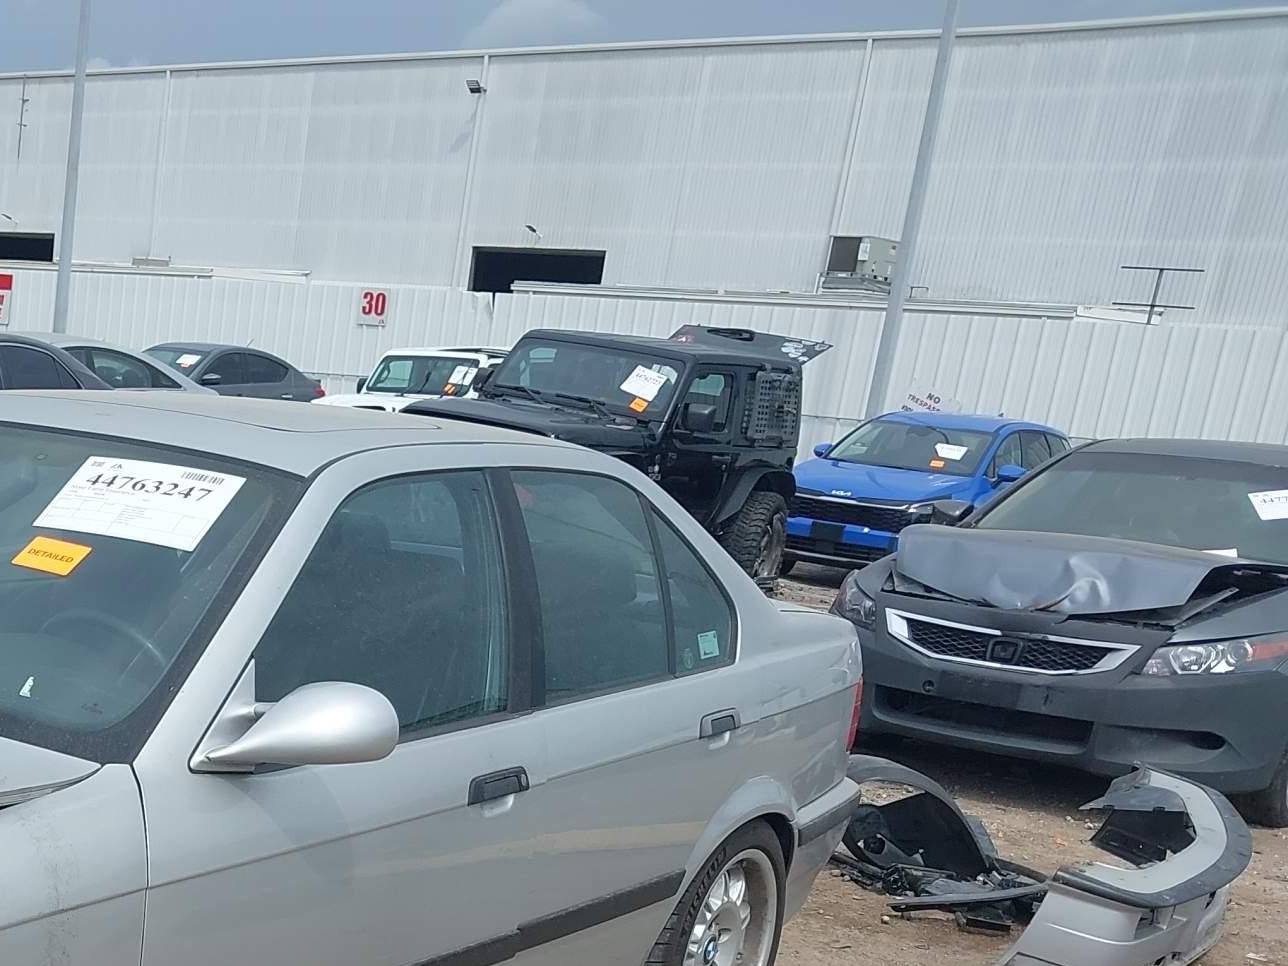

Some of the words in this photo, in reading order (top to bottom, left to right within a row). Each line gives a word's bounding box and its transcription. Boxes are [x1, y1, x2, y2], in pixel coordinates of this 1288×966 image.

[362, 291, 387, 316] 30
[926, 392, 941, 404] NO
[85, 473, 214, 501] 44763247
[27, 547, 75, 563] DETAILED
